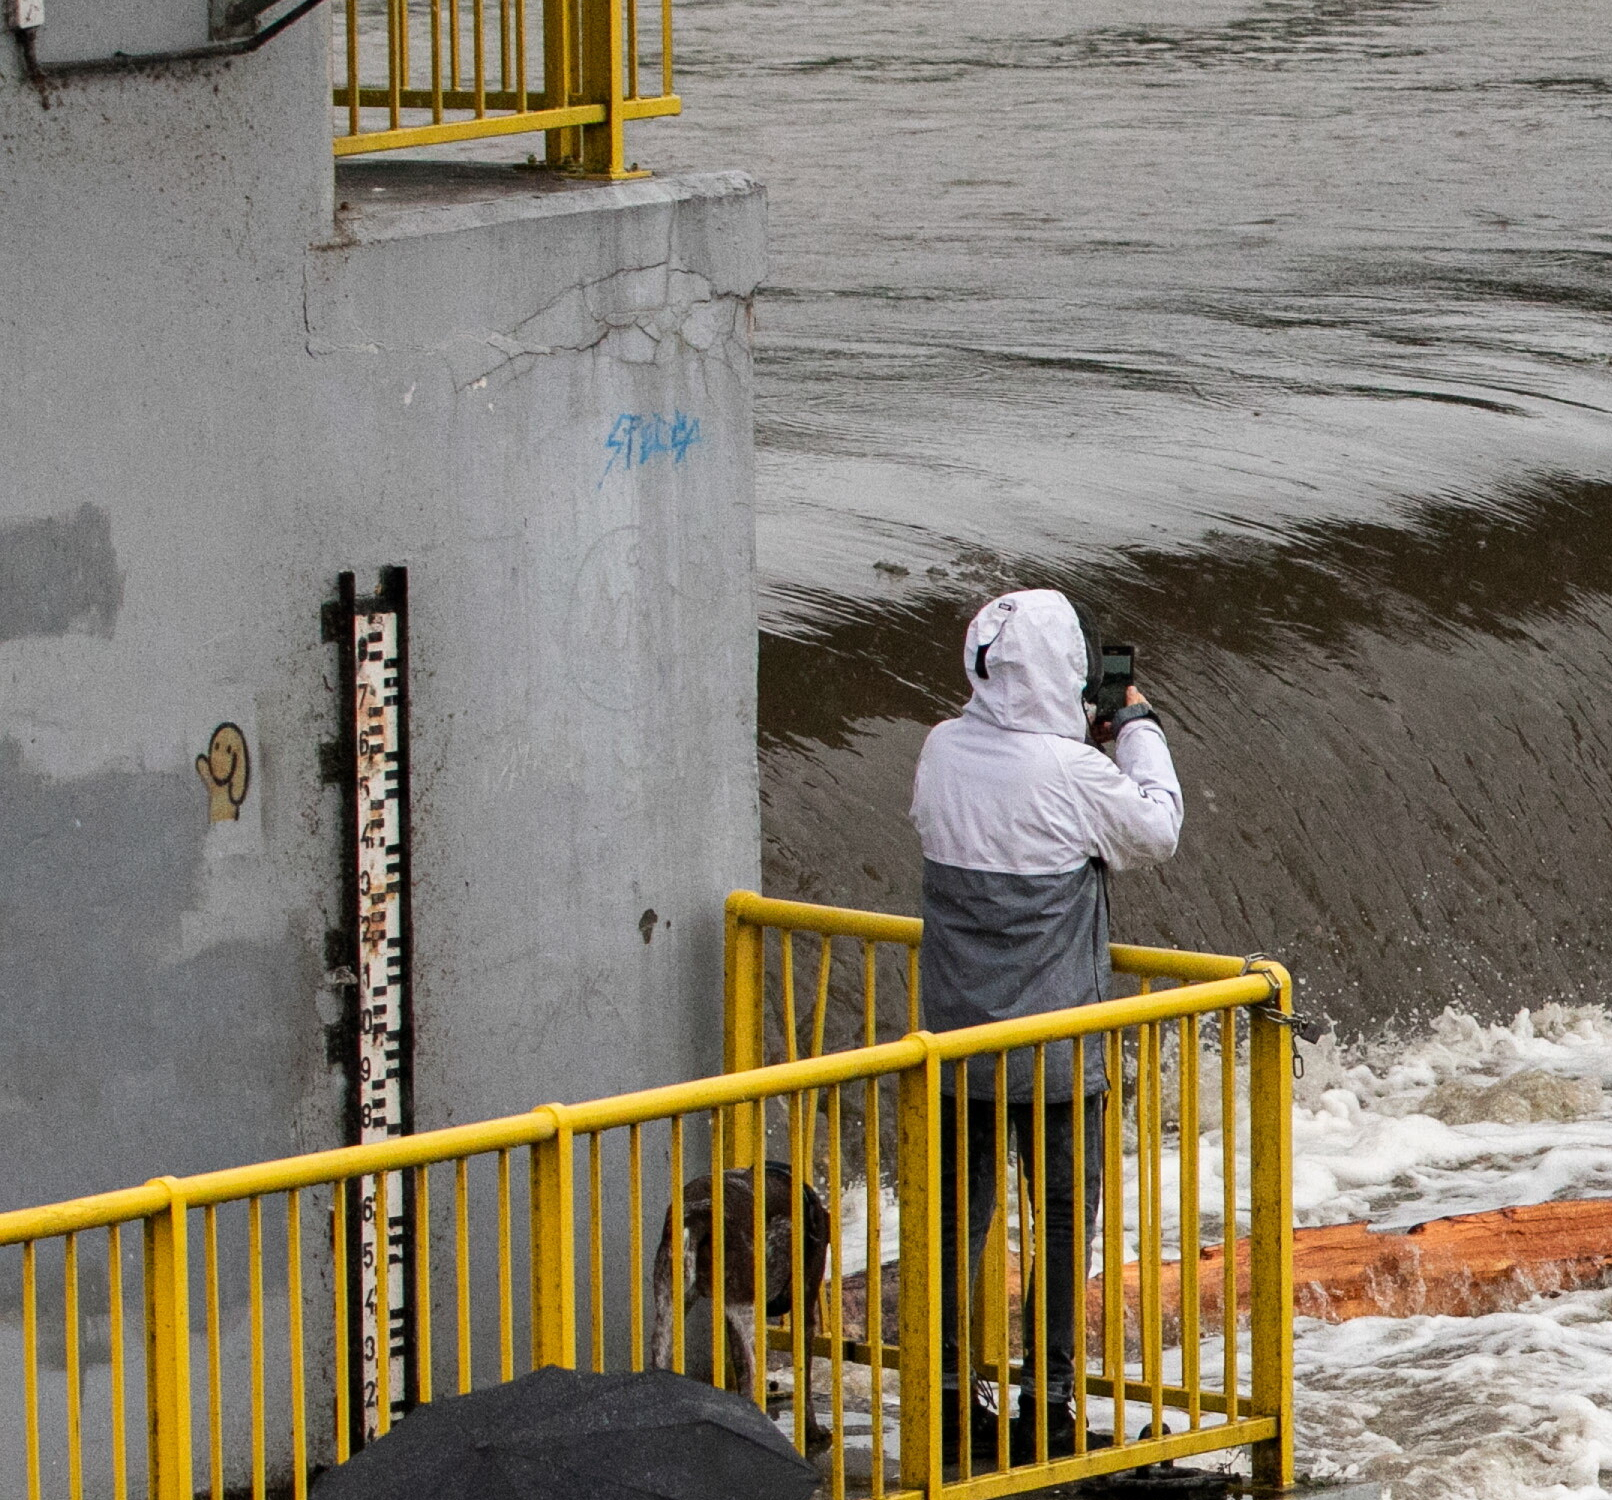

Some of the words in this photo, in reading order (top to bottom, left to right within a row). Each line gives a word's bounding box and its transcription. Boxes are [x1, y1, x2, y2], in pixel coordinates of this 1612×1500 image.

[358, 683, 368, 711] 7
[359, 730, 369, 756] 6
[359, 776, 370, 799] 5
[360, 823, 370, 849] 4
[362, 1008, 372, 1034] 0
[361, 1056, 371, 1082] 9
[361, 1103, 372, 1129] 8
[363, 1196, 373, 1222] 6
[363, 1242, 374, 1269] 5
[365, 1288, 375, 1315] 4
[365, 1335, 375, 1361] 3
[365, 1380, 376, 1408] 2
